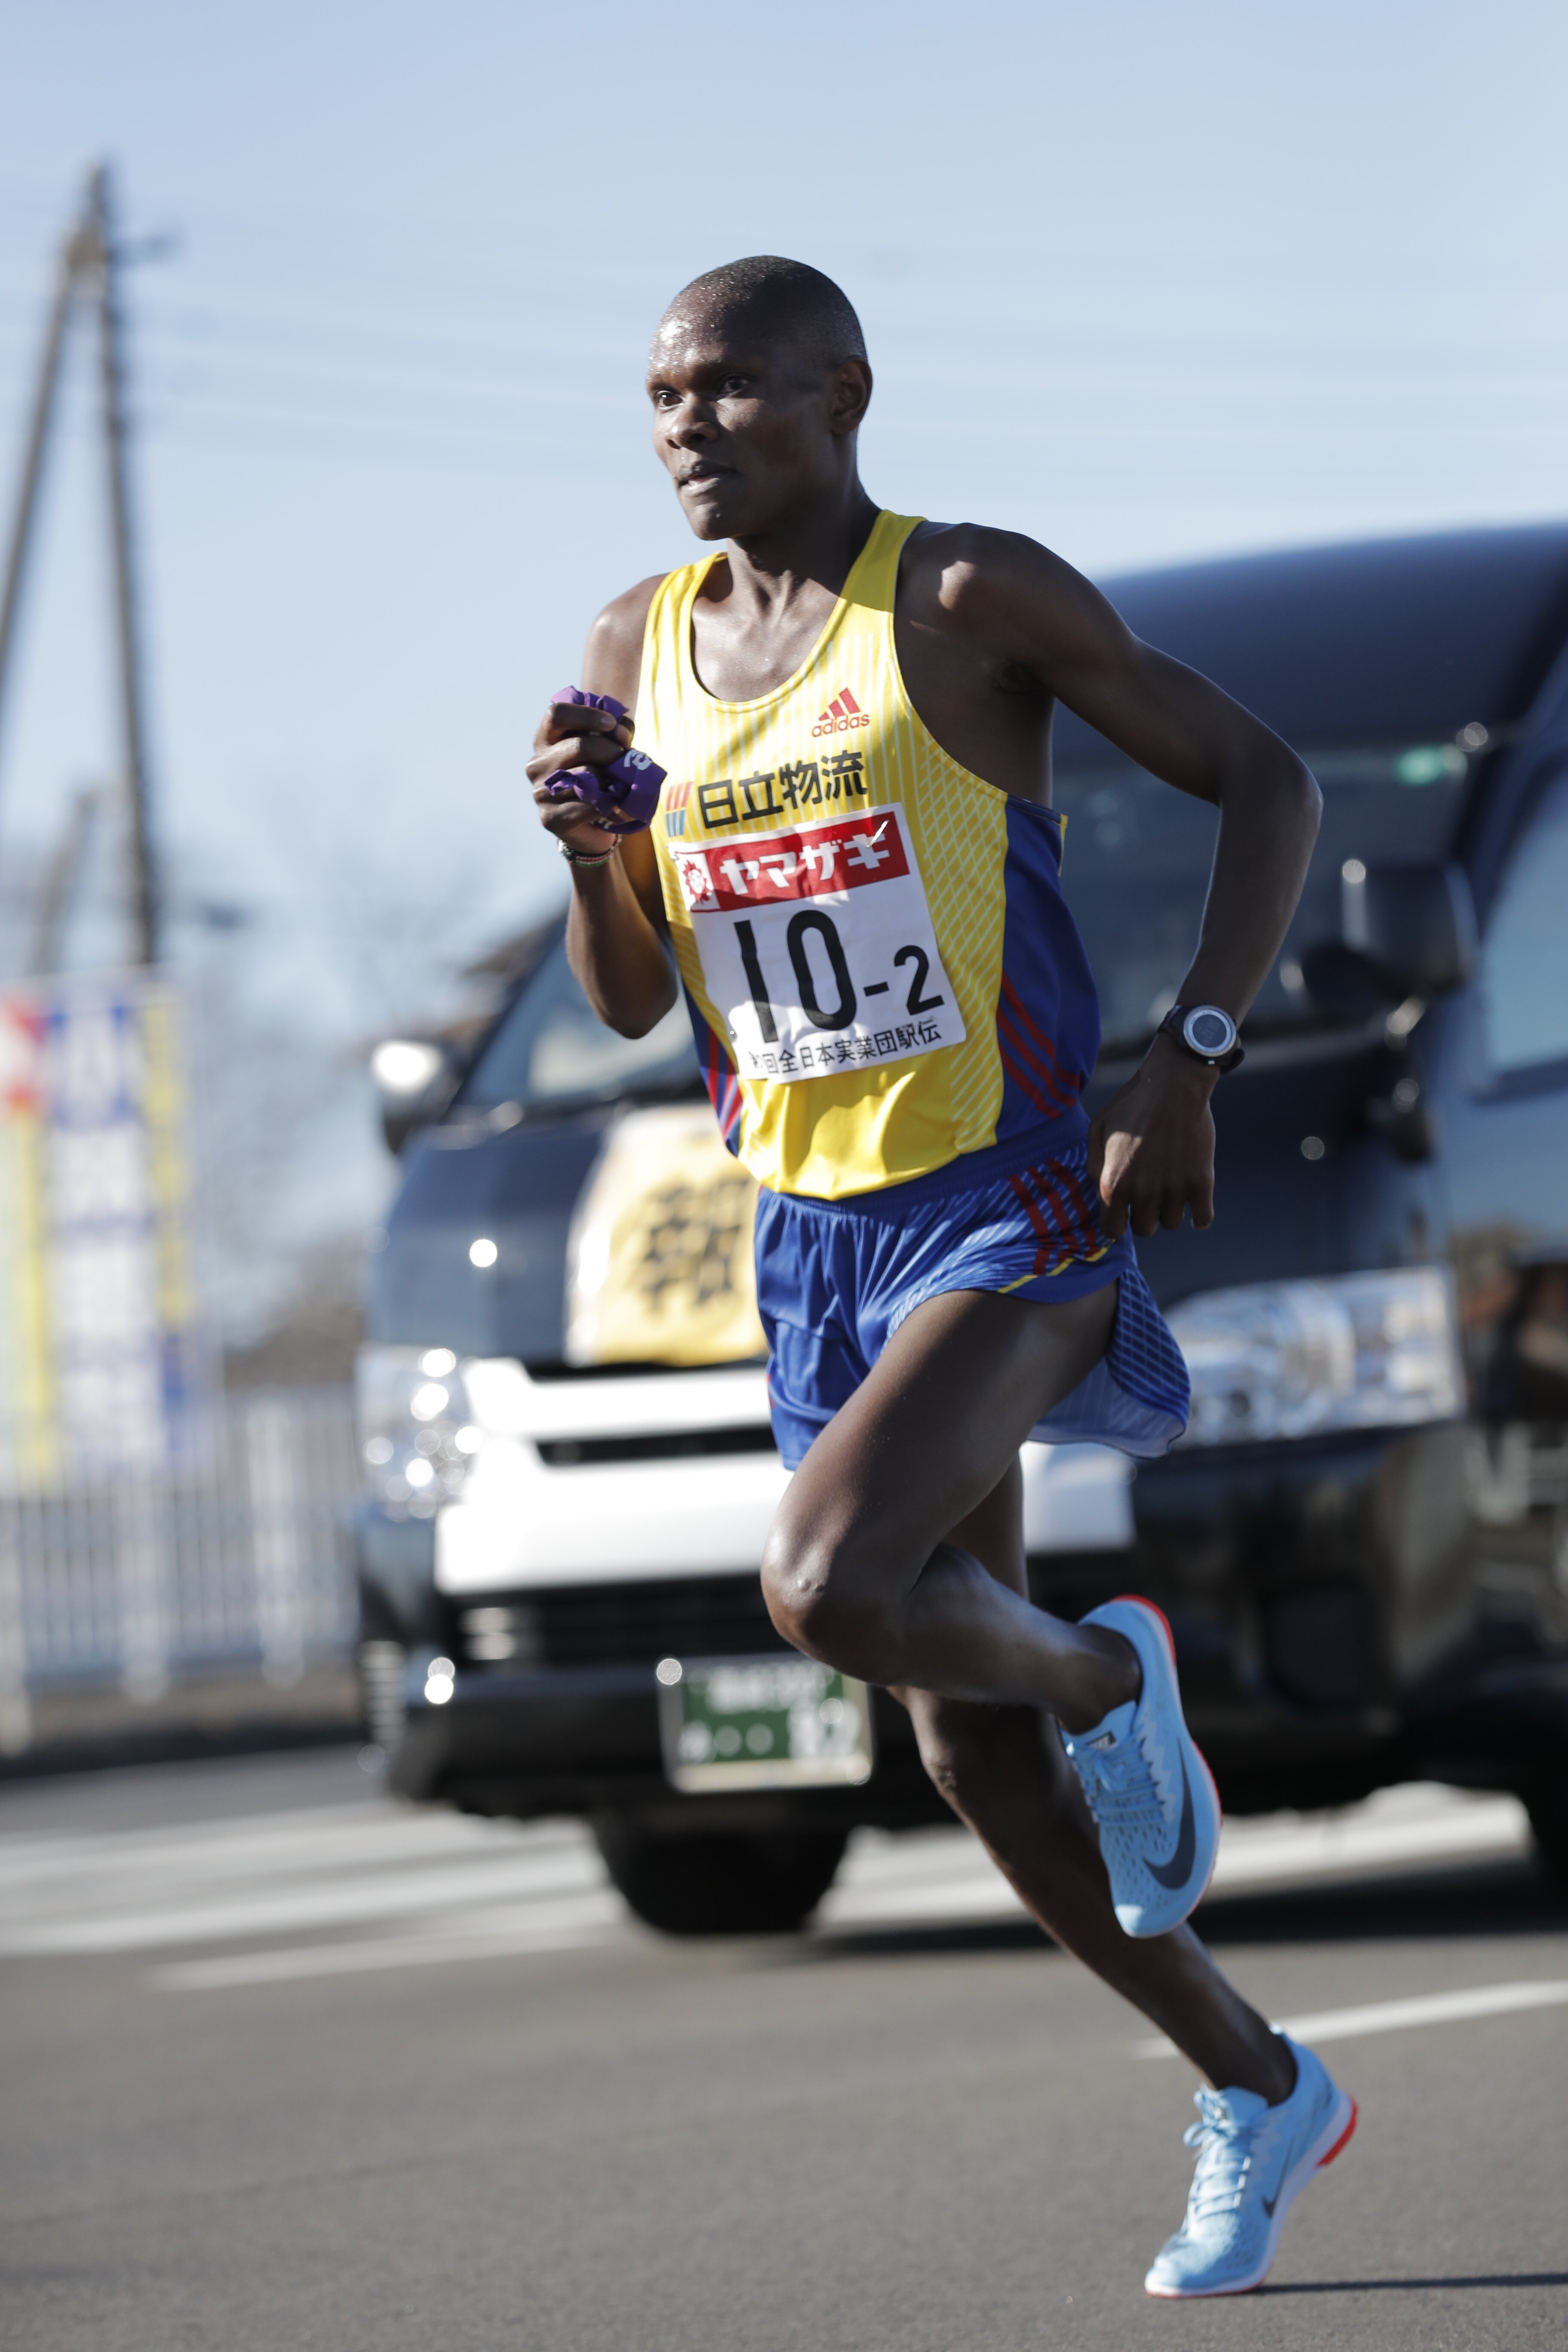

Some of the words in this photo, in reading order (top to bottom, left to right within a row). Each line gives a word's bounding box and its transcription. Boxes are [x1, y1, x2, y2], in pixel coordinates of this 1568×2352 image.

[812, 714, 870, 738] adidas
[698, 750, 867, 829] 日立物流
[720, 833, 890, 895] ヤマザキ
[734, 909, 944, 1044] 10-2
[748, 1019, 941, 1074] 回全日本実業団駅伝
